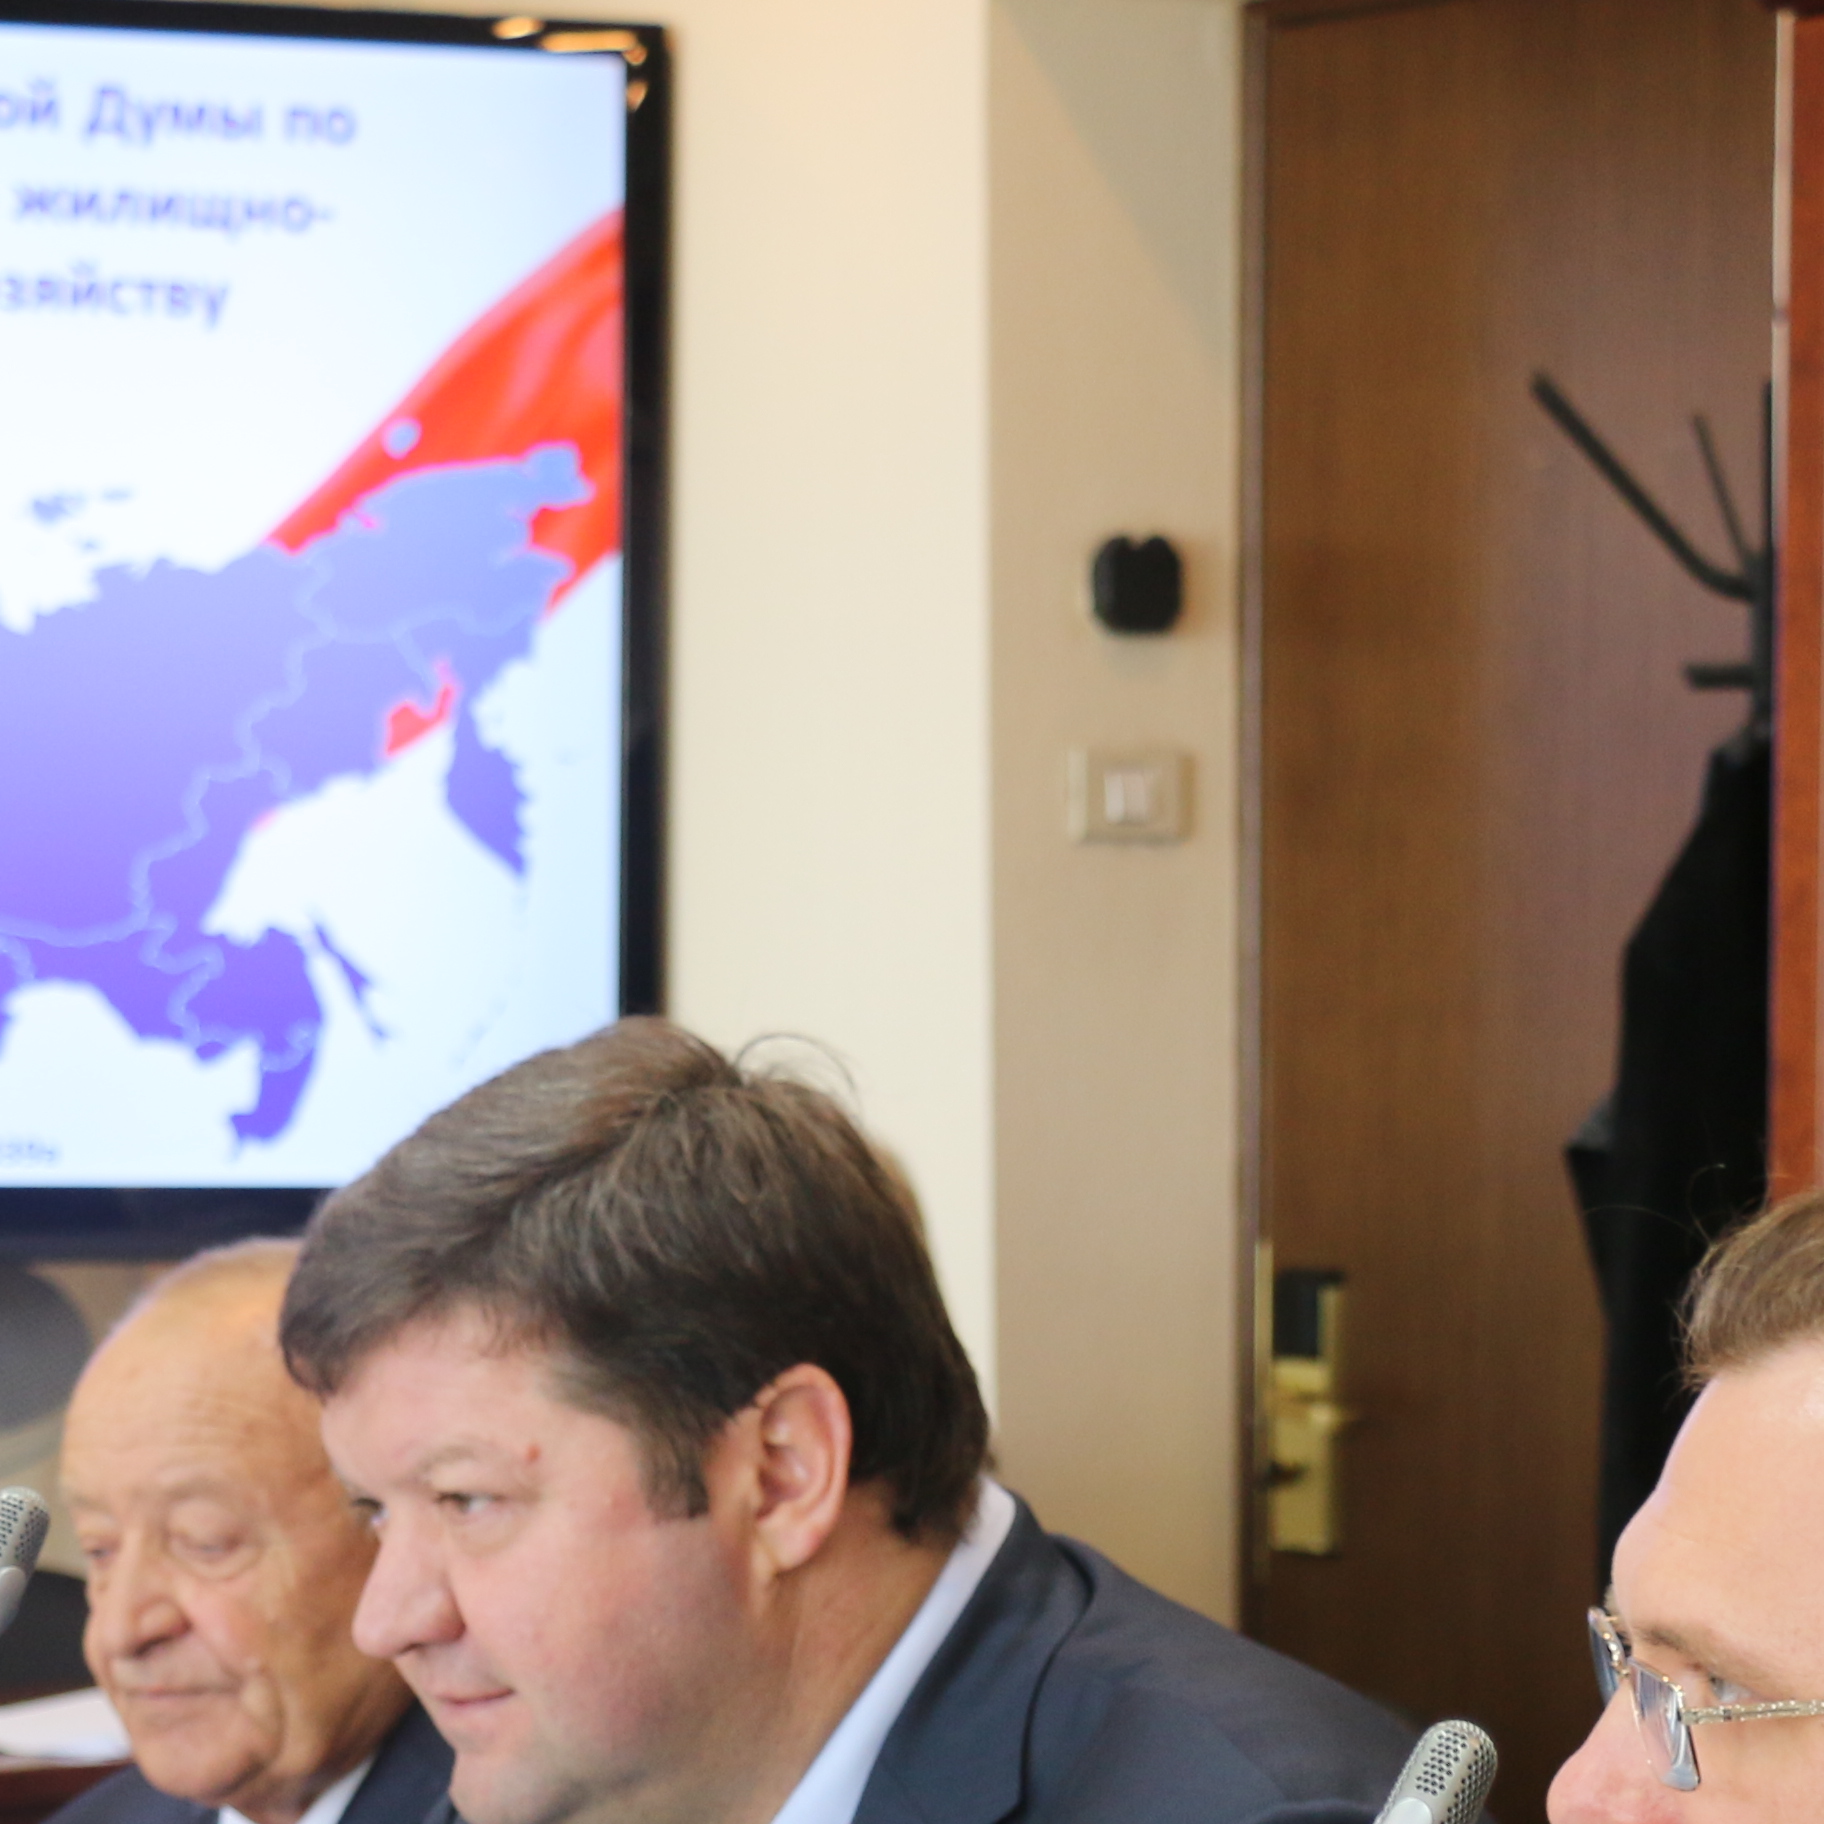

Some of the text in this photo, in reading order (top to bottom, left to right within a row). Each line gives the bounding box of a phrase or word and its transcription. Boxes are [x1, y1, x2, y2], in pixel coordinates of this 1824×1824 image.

[82, 80, 266, 148] Думы
[282, 104, 359, 147] по
[15, 186, 336, 242] жилищно-
